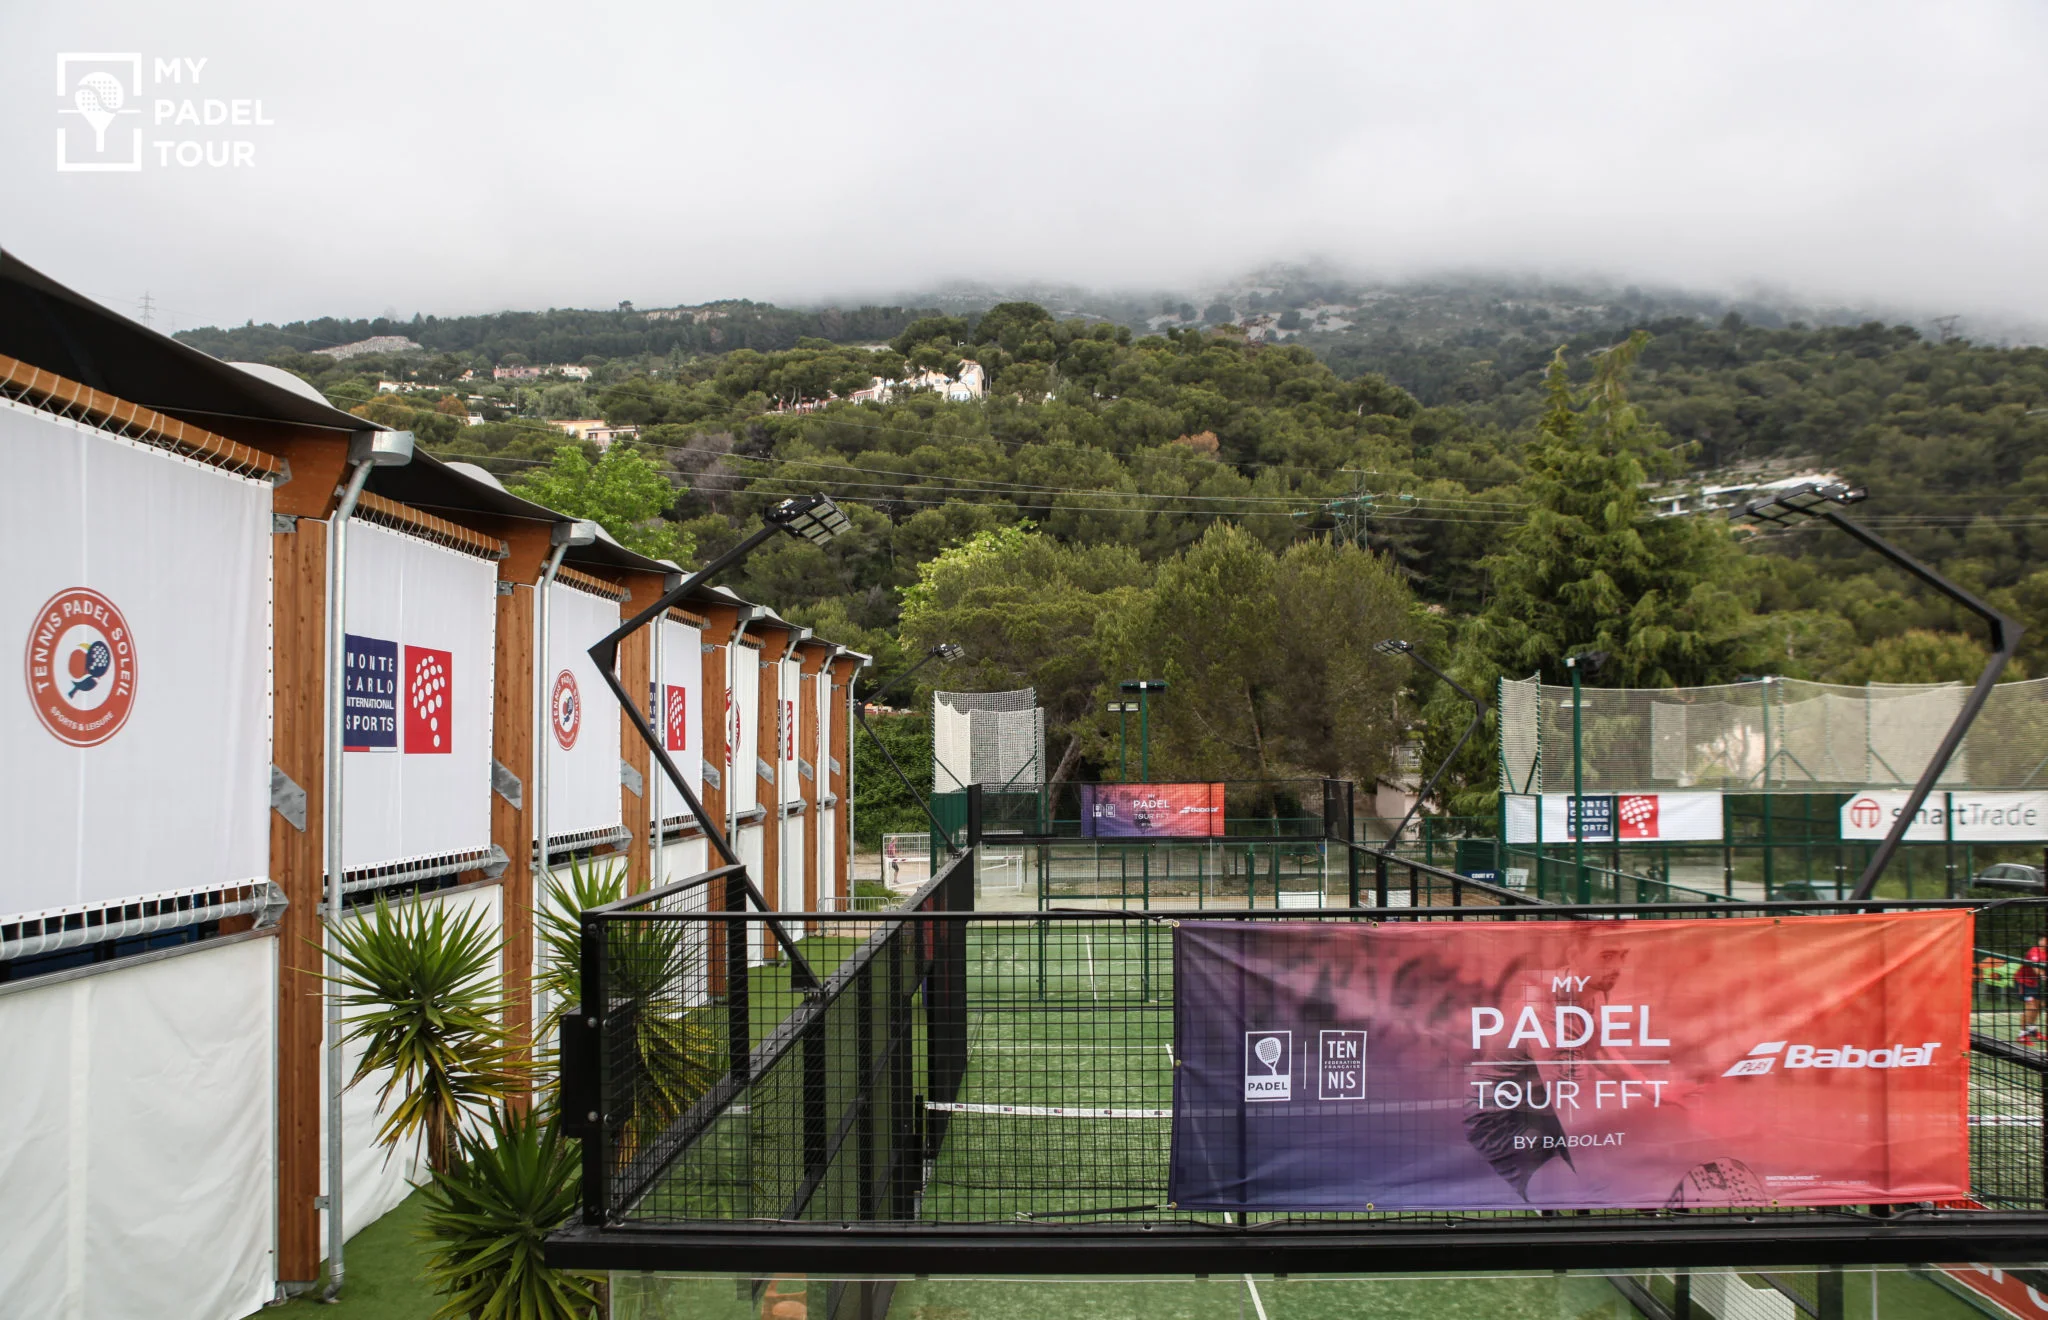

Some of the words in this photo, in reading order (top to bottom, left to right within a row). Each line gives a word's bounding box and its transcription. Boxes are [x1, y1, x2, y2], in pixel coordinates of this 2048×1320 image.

[34, 612, 62, 694] TENNIS
[62, 600, 111, 628] PADEL
[111, 627, 131, 697] SOLEIL
[346, 651, 394, 673] MONTE
[346, 675, 394, 695] CARLO
[50, 706, 77, 730] SPORTS
[85, 711, 115, 731] LEISURE
[346, 714, 394, 732] SPORTS
[1133, 799, 1170, 809] PADEL
[1569, 824, 1609, 832] SORTS
[1551, 975, 1591, 993] MY
[1471, 1005, 1671, 1049] PADEL
[1327, 1041, 1357, 1058] TEN
[1248, 1082, 1288, 1091] PADEL
[1328, 1071, 1356, 1089] NIS
[1470, 1080, 1580, 1110] TOUR
[1595, 1080, 1669, 1110] FFT
[1513, 1135, 1538, 1150] BY
[1543, 1132, 1625, 1149] BABOLAT
